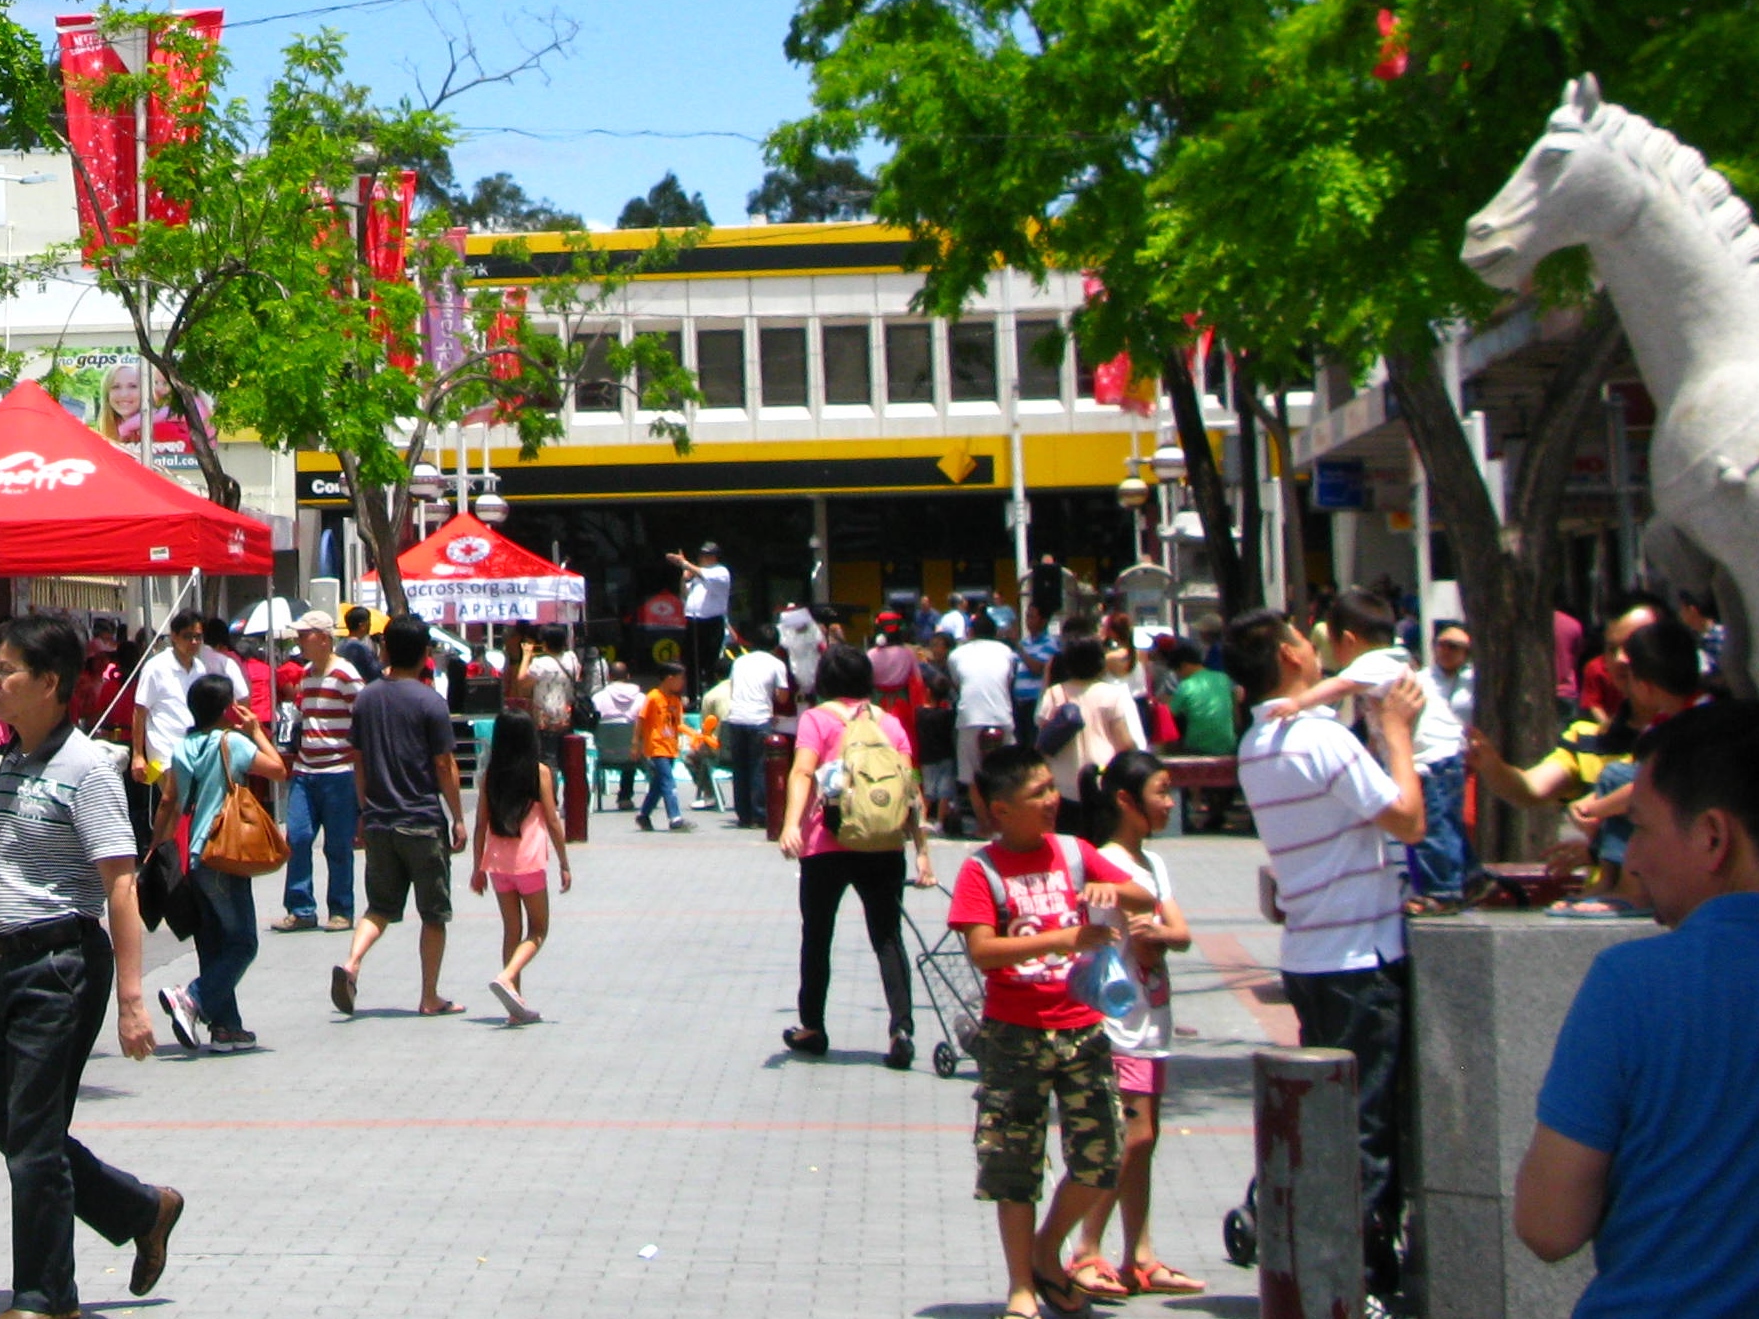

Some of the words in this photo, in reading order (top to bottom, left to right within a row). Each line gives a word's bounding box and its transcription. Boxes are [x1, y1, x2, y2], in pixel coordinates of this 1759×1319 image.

[57, 356, 74, 366] no
[76, 353, 118, 369] gaps
[403, 581, 529, 598] dcross.org.au
[457, 601, 533, 618] APPEAL
